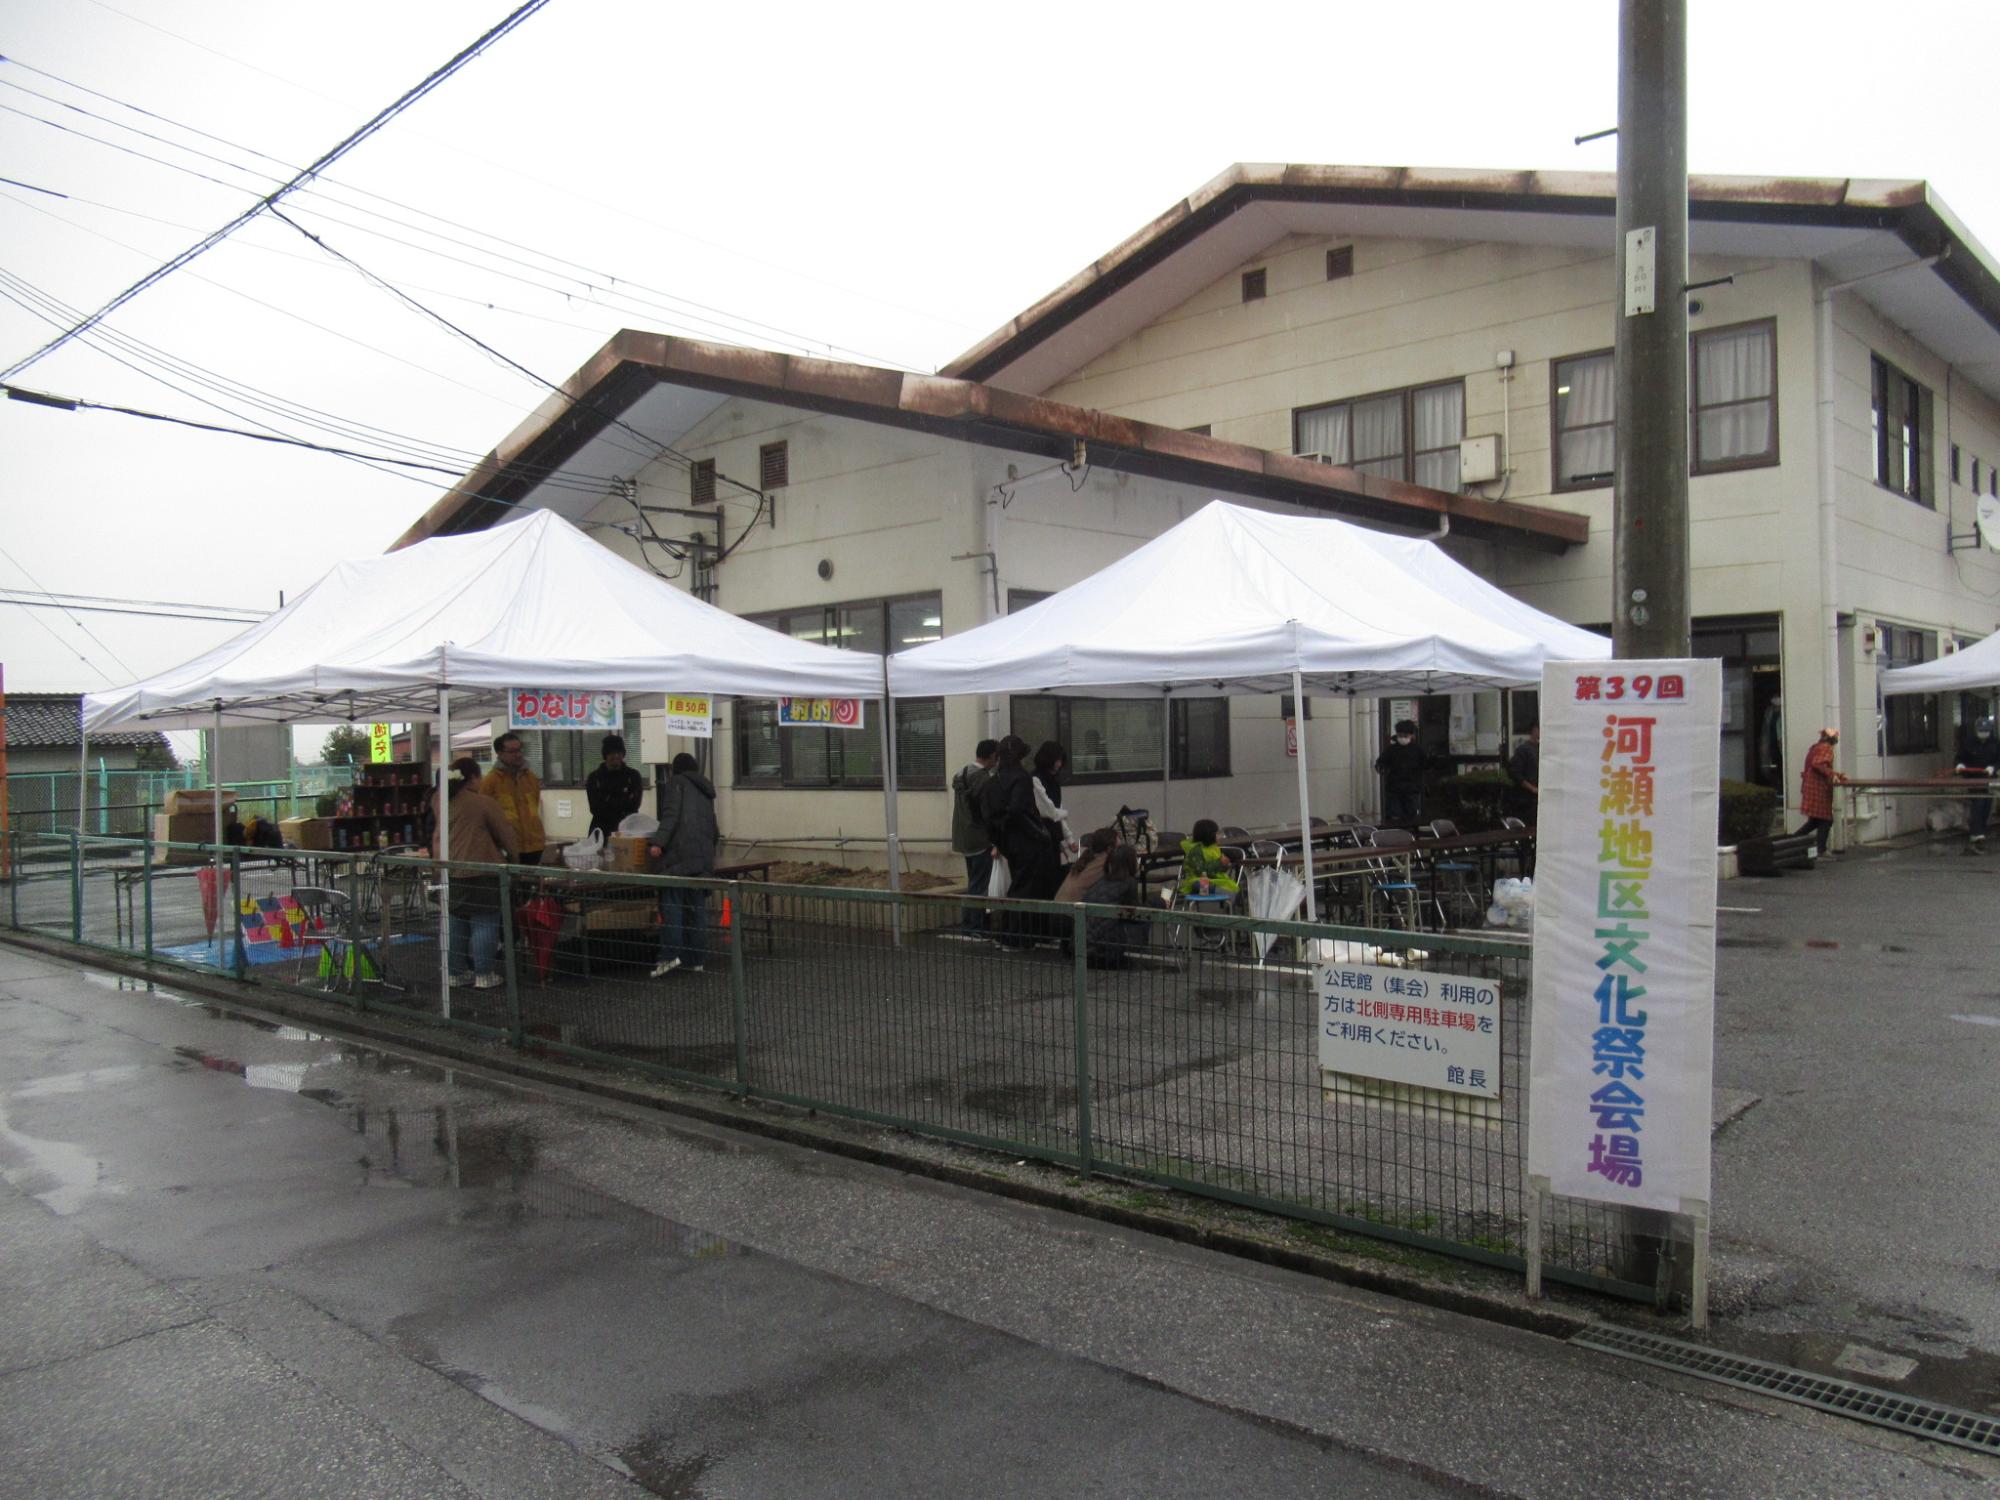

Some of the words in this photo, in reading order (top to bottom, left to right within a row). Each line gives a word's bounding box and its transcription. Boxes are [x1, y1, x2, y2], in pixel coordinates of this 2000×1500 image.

[1574, 674, 1684, 701] 第39回
[516, 692, 592, 719] わなげ
[1587, 714, 1657, 1188] 河瀬地区文化祭会場
[1324, 995, 1493, 1034] 方は北側専用駐車場を
[1326, 1021, 1448, 1055] ご利用ください。
